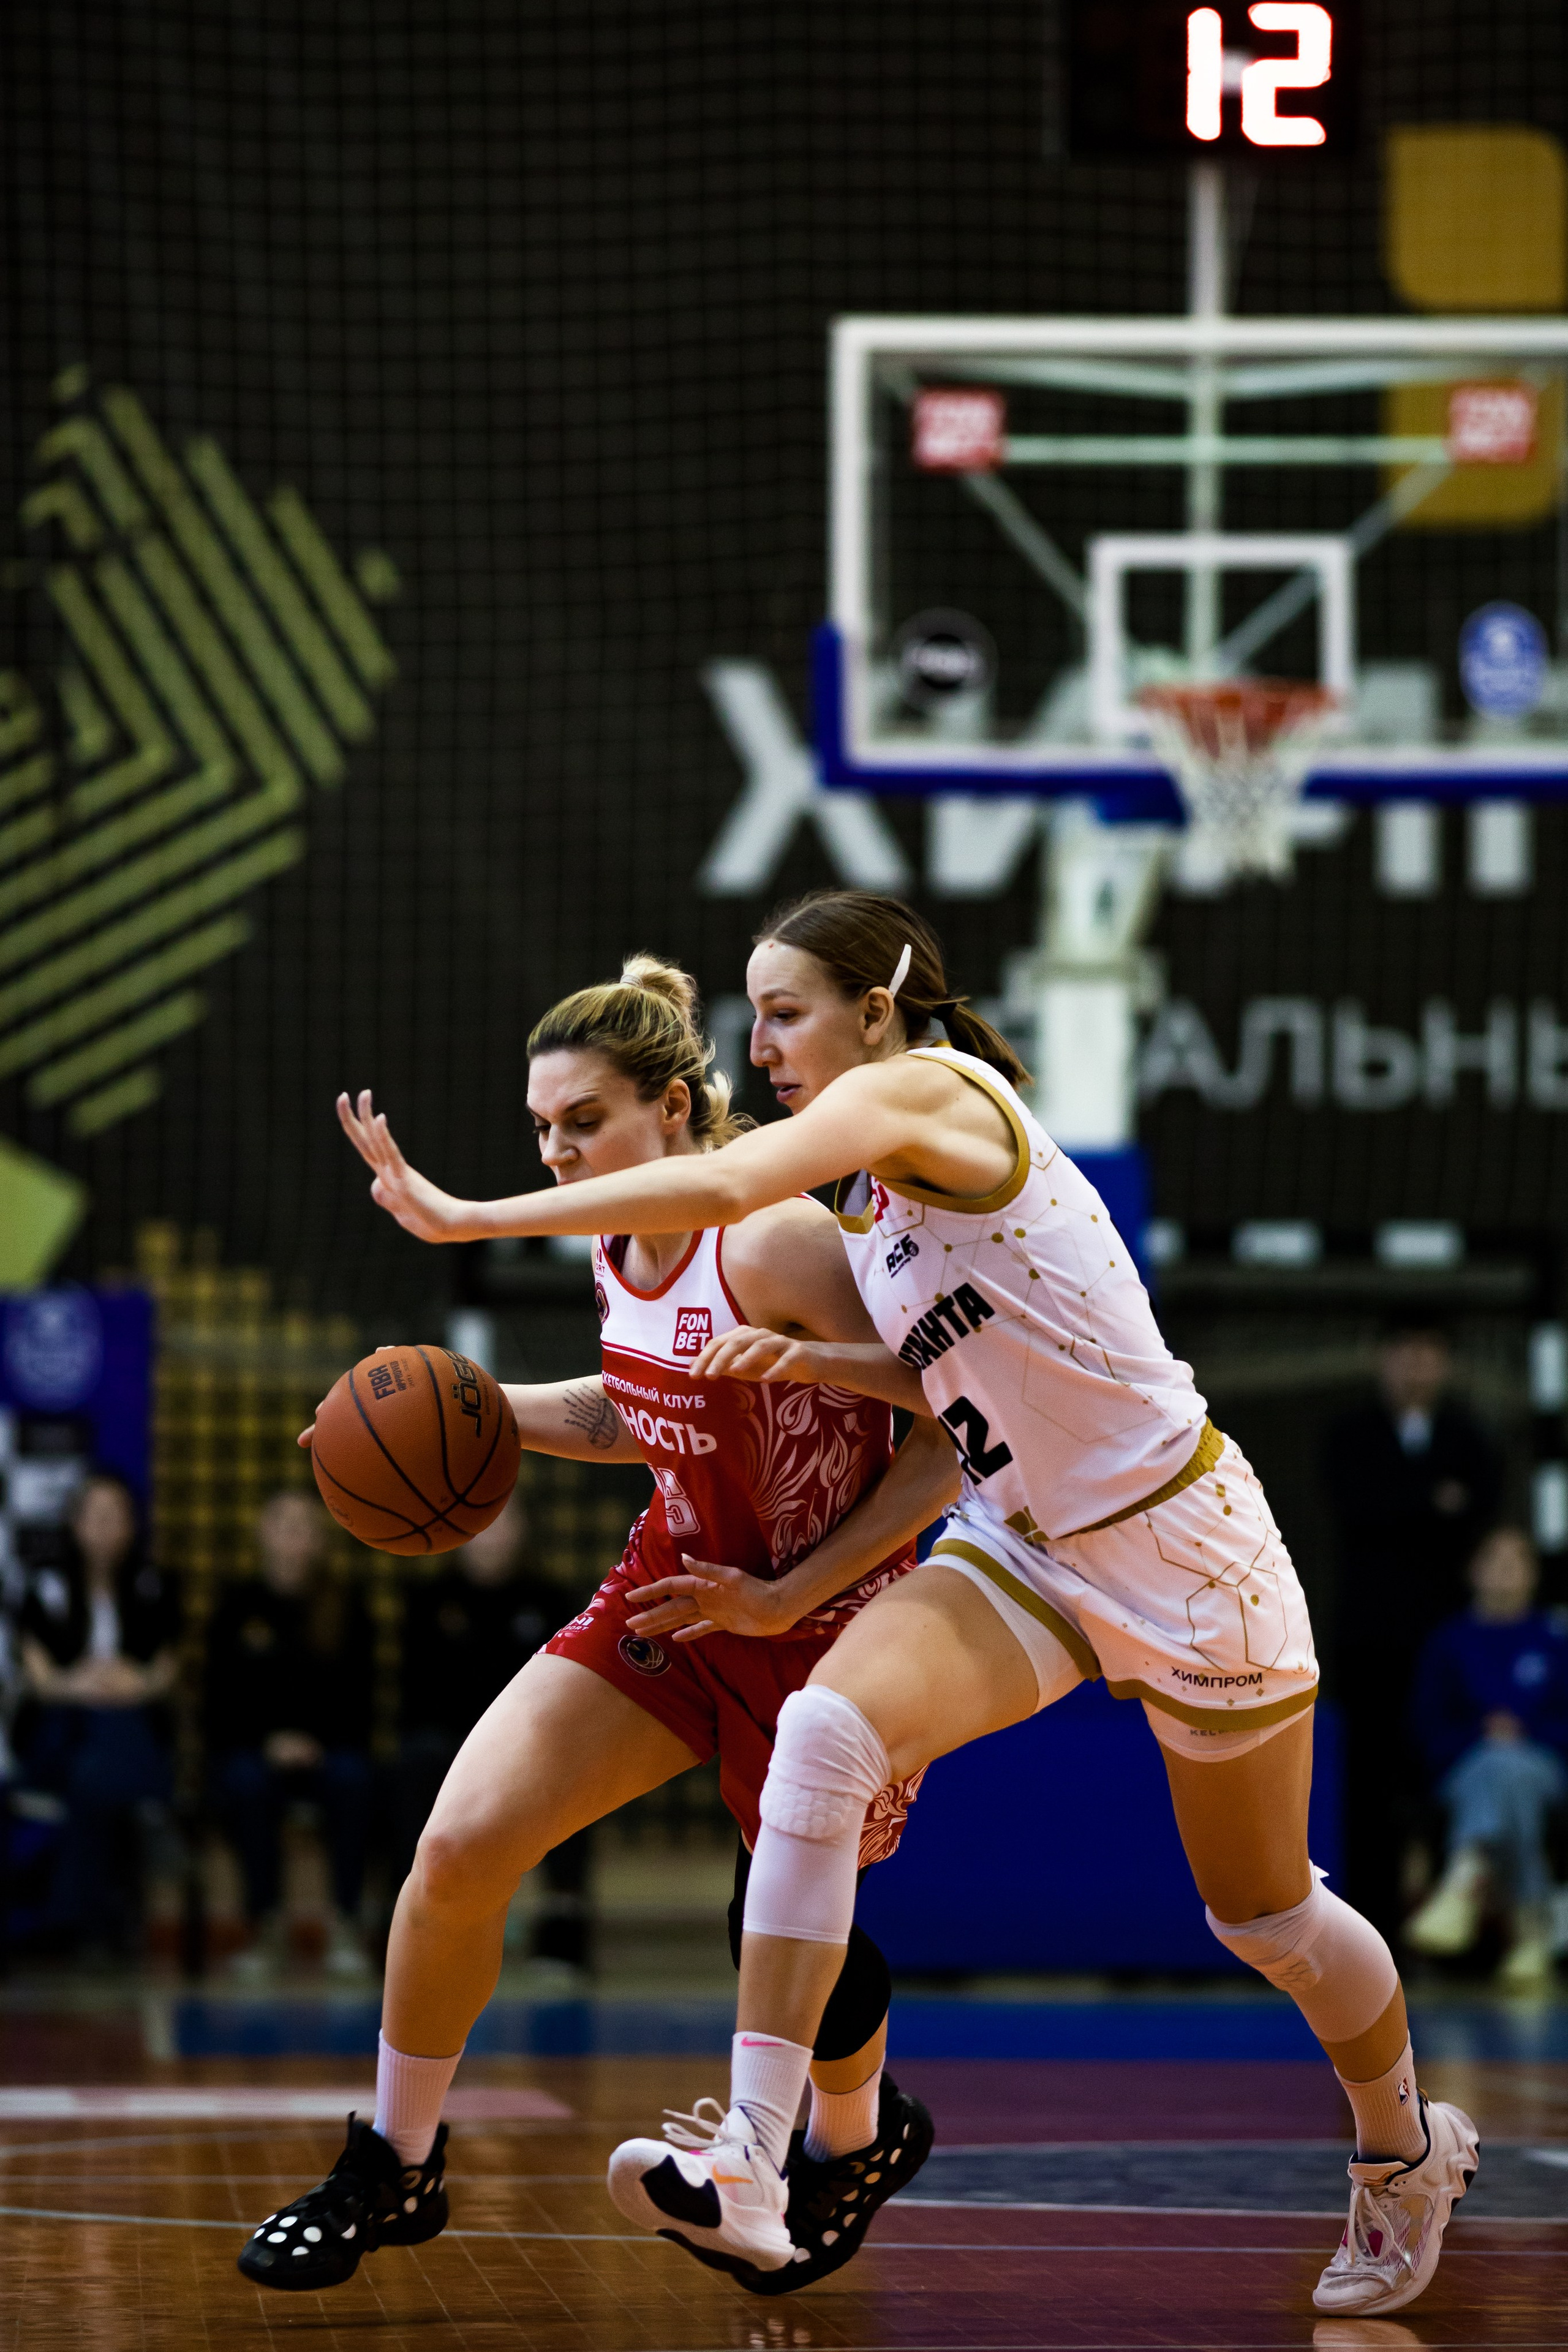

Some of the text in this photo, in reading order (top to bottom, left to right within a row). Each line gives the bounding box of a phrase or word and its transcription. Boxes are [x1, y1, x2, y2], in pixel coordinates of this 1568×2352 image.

[1186, 2, 1332, 146] 12
[677, 1313, 709, 1331] FON
[675, 1332, 710, 1350] BET
[368, 1363, 396, 1400] FIBA
[439, 1347, 481, 1438] JÖGE
[663, 1394, 706, 1409] КЛУБ
[612, 1400, 717, 1455] НОСТЬ
[1171, 1666, 1263, 1689] ХИМПРОМ
